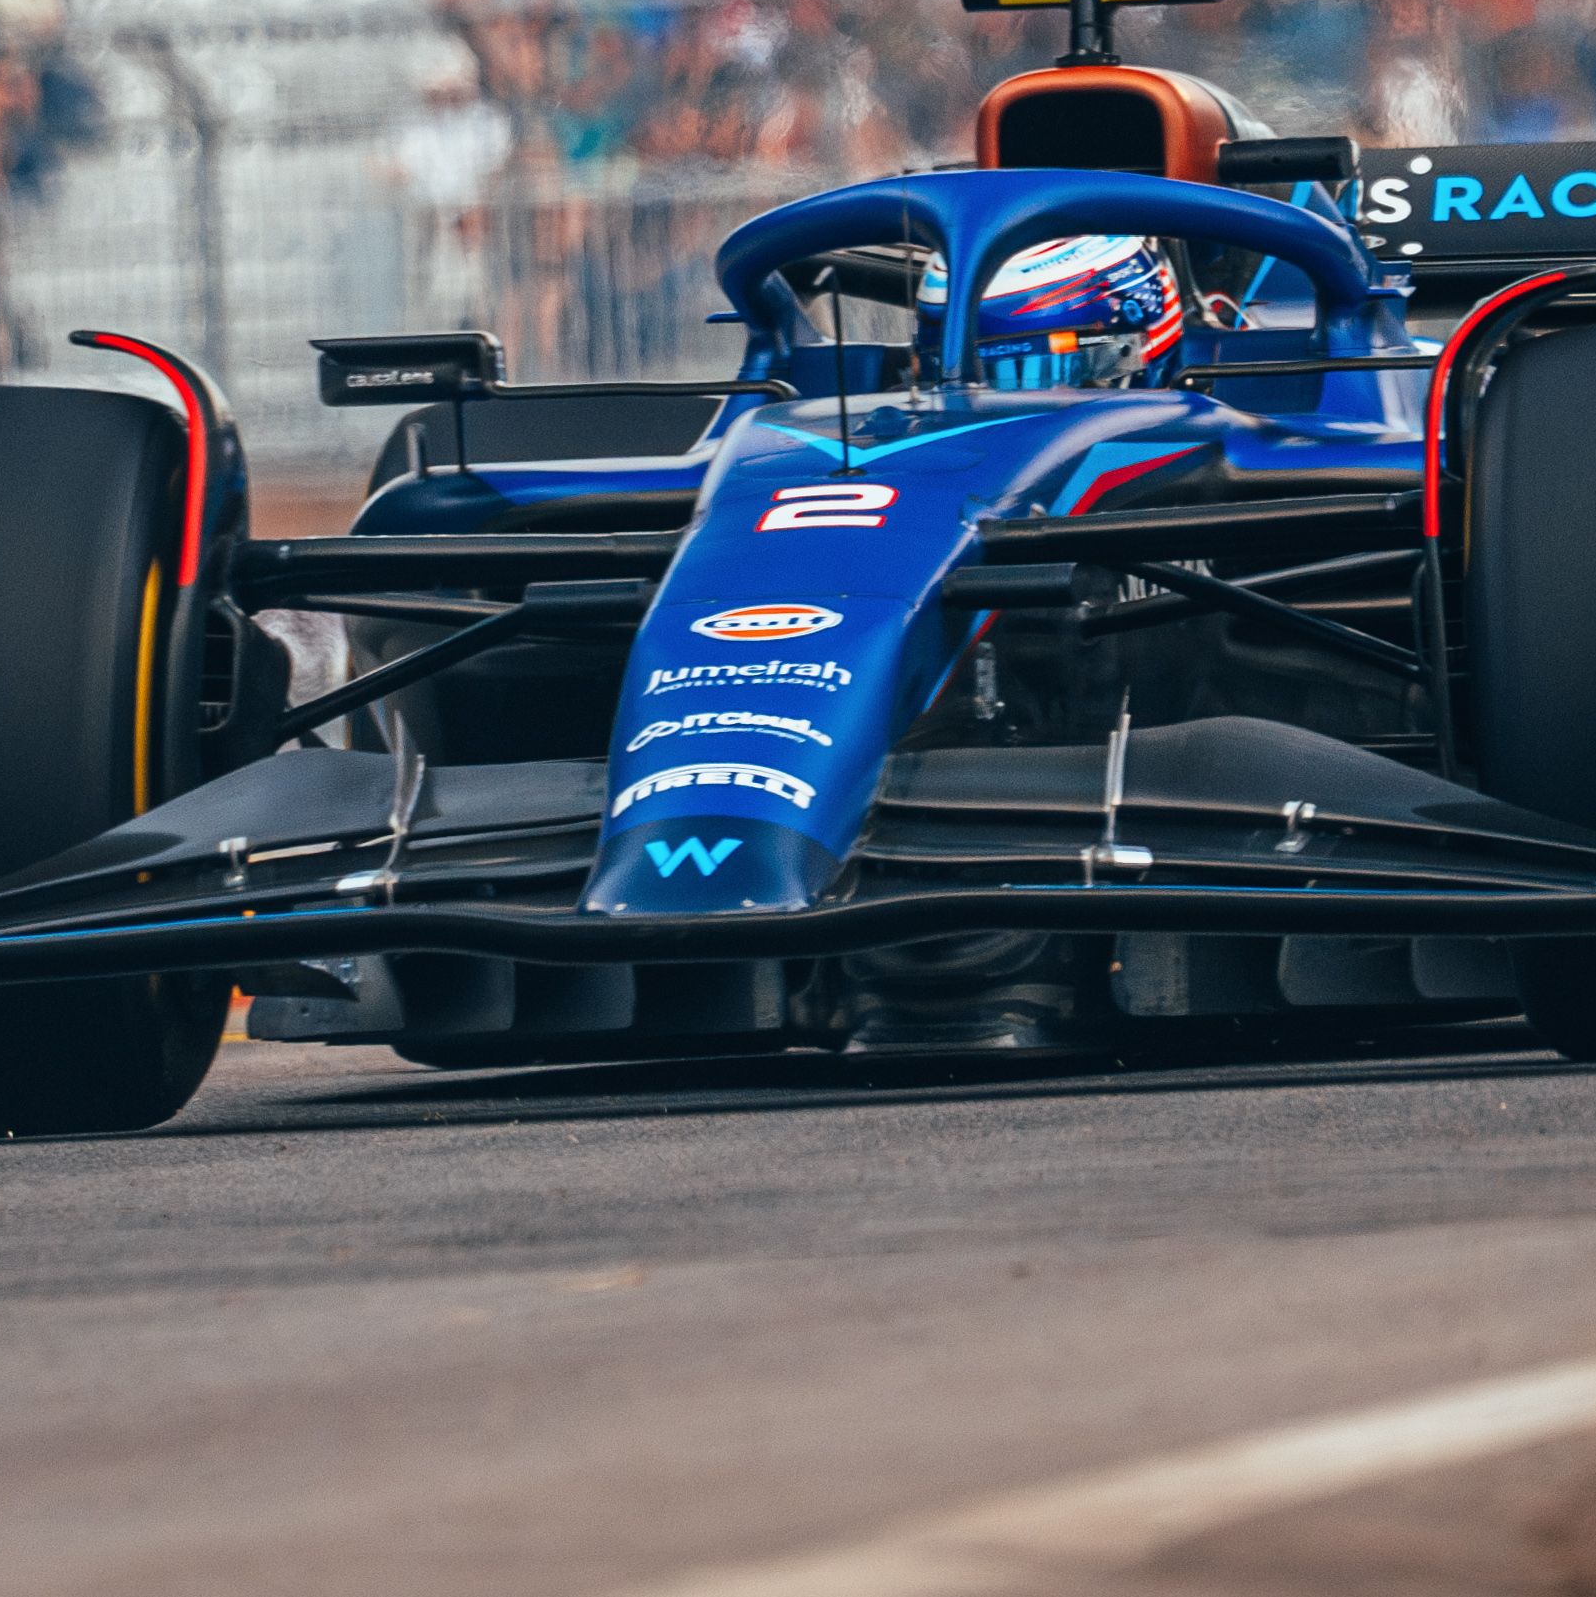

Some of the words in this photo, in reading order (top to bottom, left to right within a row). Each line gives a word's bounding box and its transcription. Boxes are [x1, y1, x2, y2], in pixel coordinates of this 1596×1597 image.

[754, 483, 900, 533] 2
[704, 615, 828, 629] Gulf
[643, 660, 852, 695] Jumeirah
[653, 679, 727, 695] HOTELS
[751, 677, 838, 692] RESORTS
[611, 763, 817, 818] PIRELLI
